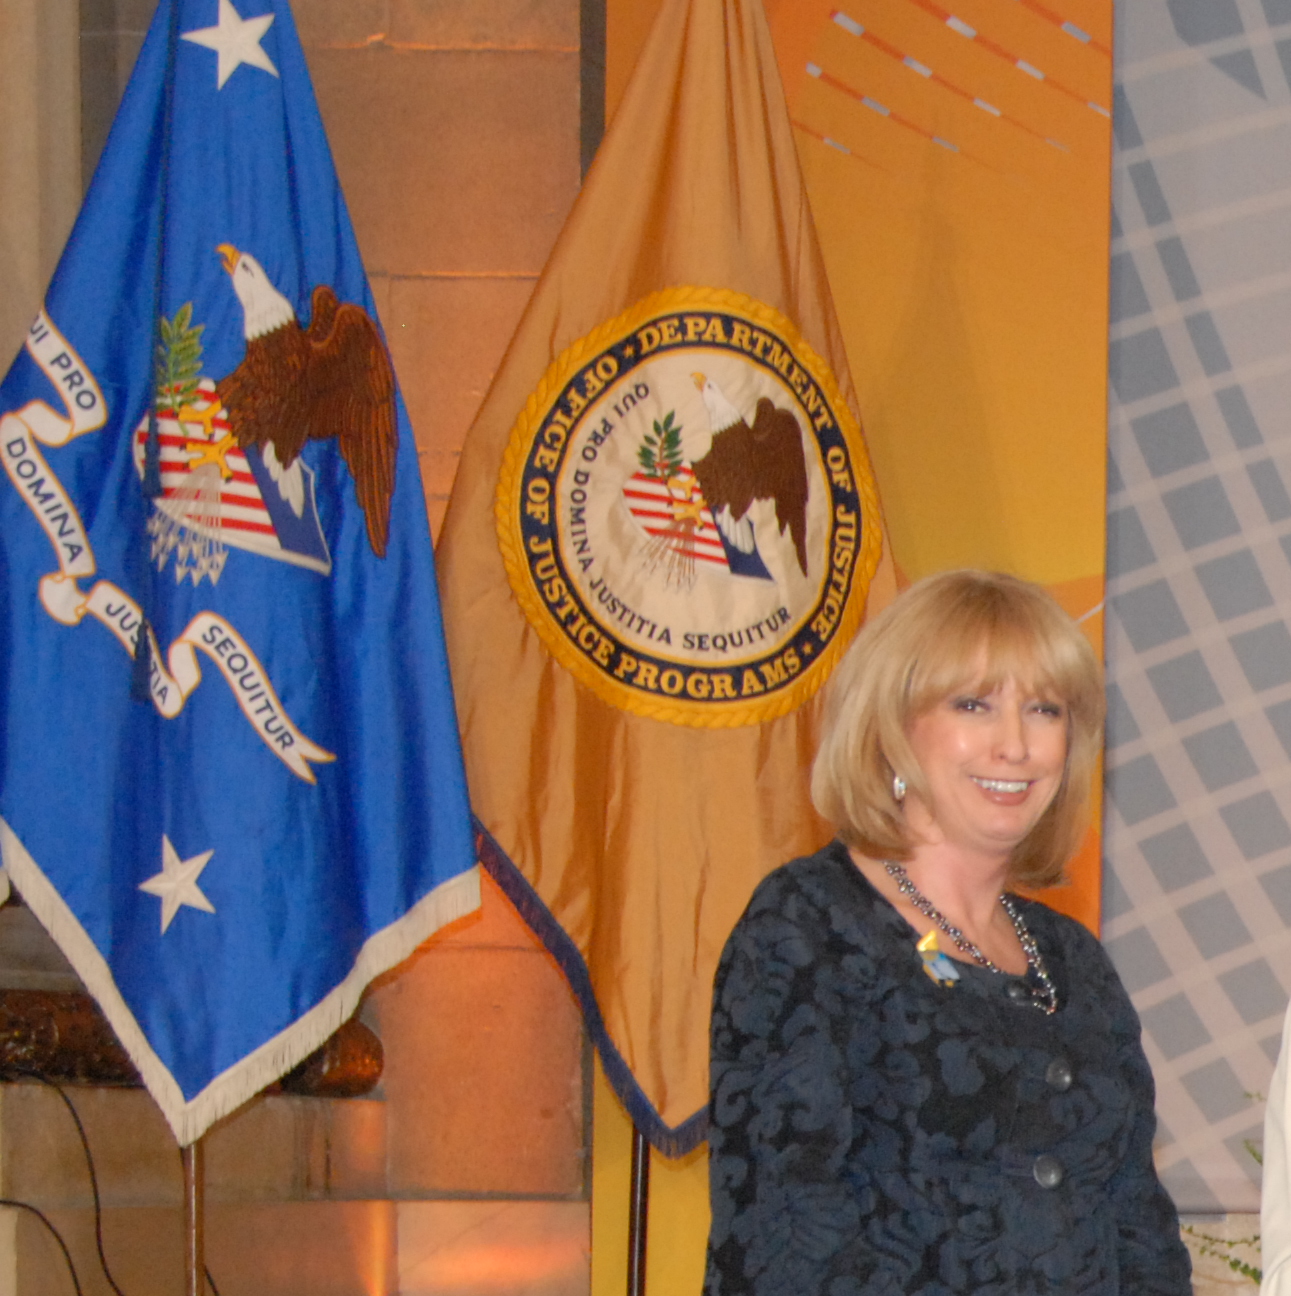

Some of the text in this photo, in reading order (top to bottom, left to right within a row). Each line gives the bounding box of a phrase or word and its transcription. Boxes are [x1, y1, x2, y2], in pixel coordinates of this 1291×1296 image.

[50, 351, 96, 412] PRO
[637, 315, 857, 641] DEPARTMENT OF JUSTICE
[6, 436, 84, 564] DOMINA
[527, 359, 801, 700] OFFICE OF JUSTICE PROGRAMS
[569, 382, 792, 653] QUI PRO DOMINA JUSTITIA SEQUITUR
[201, 624, 295, 752] SEQUITUR
